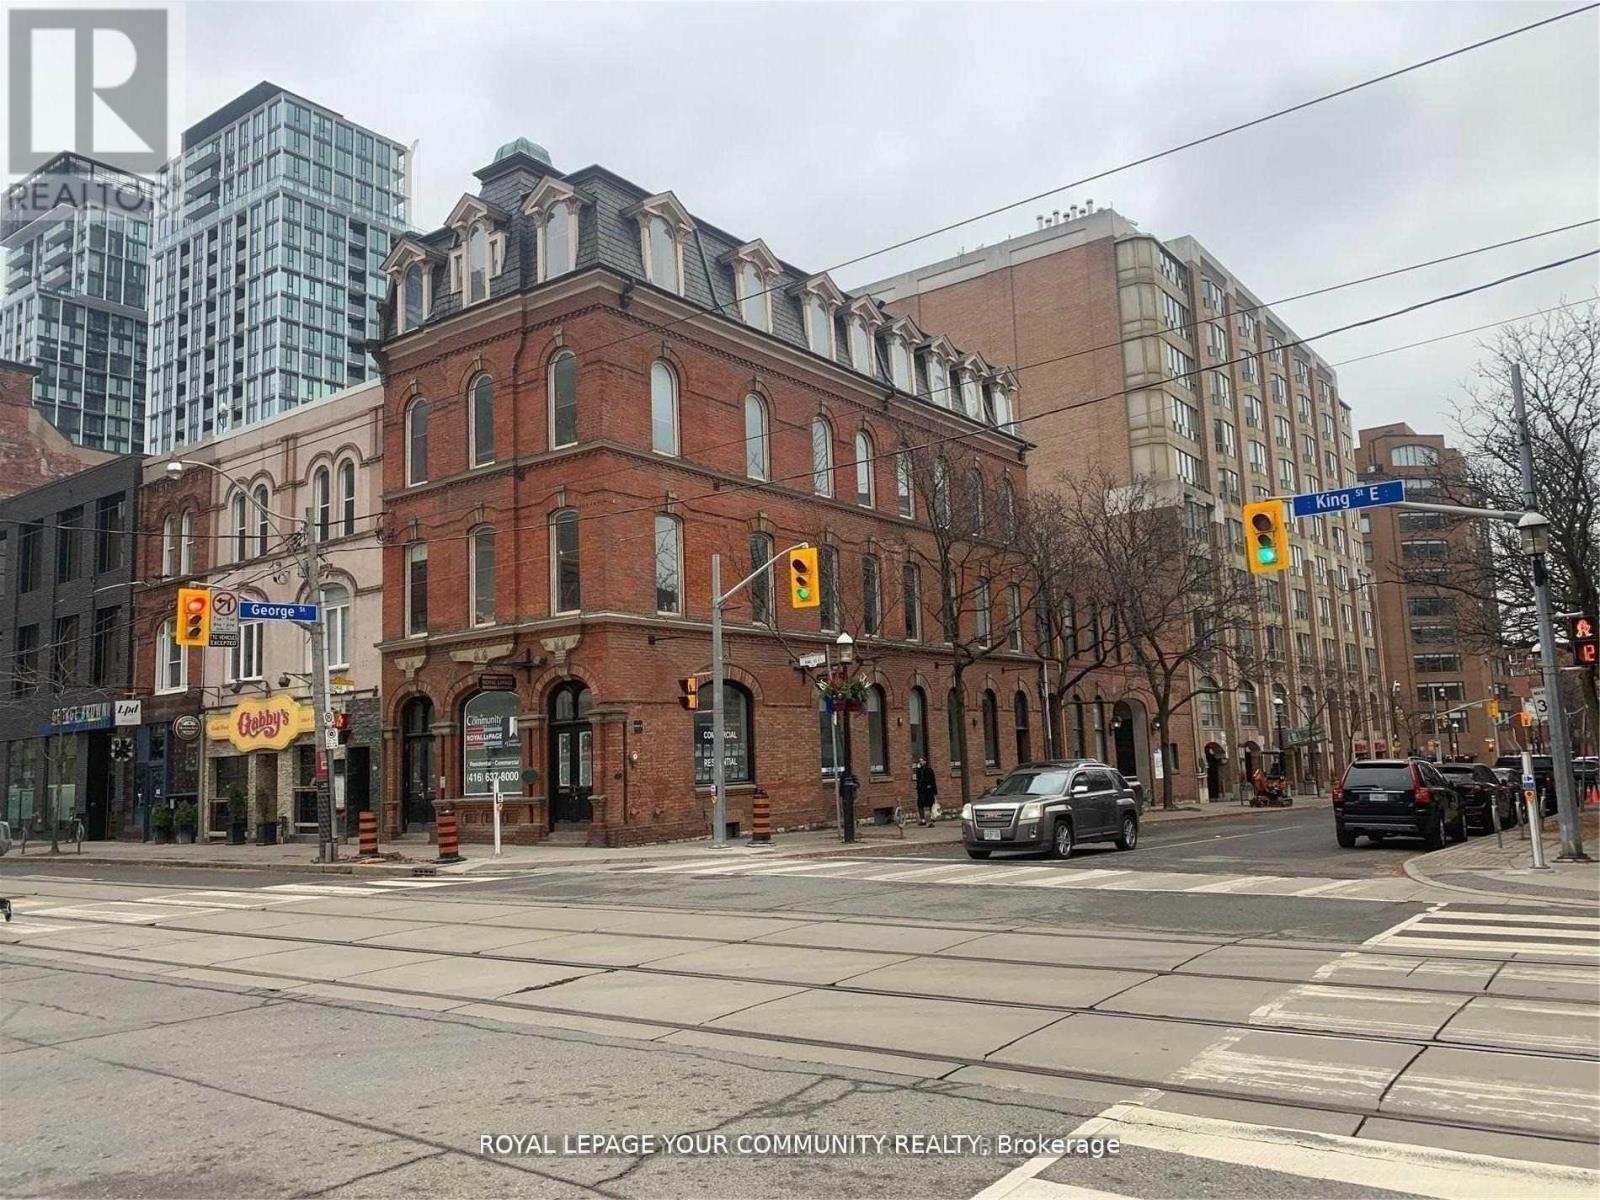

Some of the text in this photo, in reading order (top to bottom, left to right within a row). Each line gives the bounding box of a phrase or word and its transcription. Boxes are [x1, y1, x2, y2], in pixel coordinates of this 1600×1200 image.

[1316, 486, 1380, 509] King St E
[251, 604, 295, 618] George
[1583, 644, 1596, 662] 12
[237, 708, 290, 739] Gabby's
[466, 713, 504, 726] Community
[467, 770, 519, 784] (416) 637-8000
